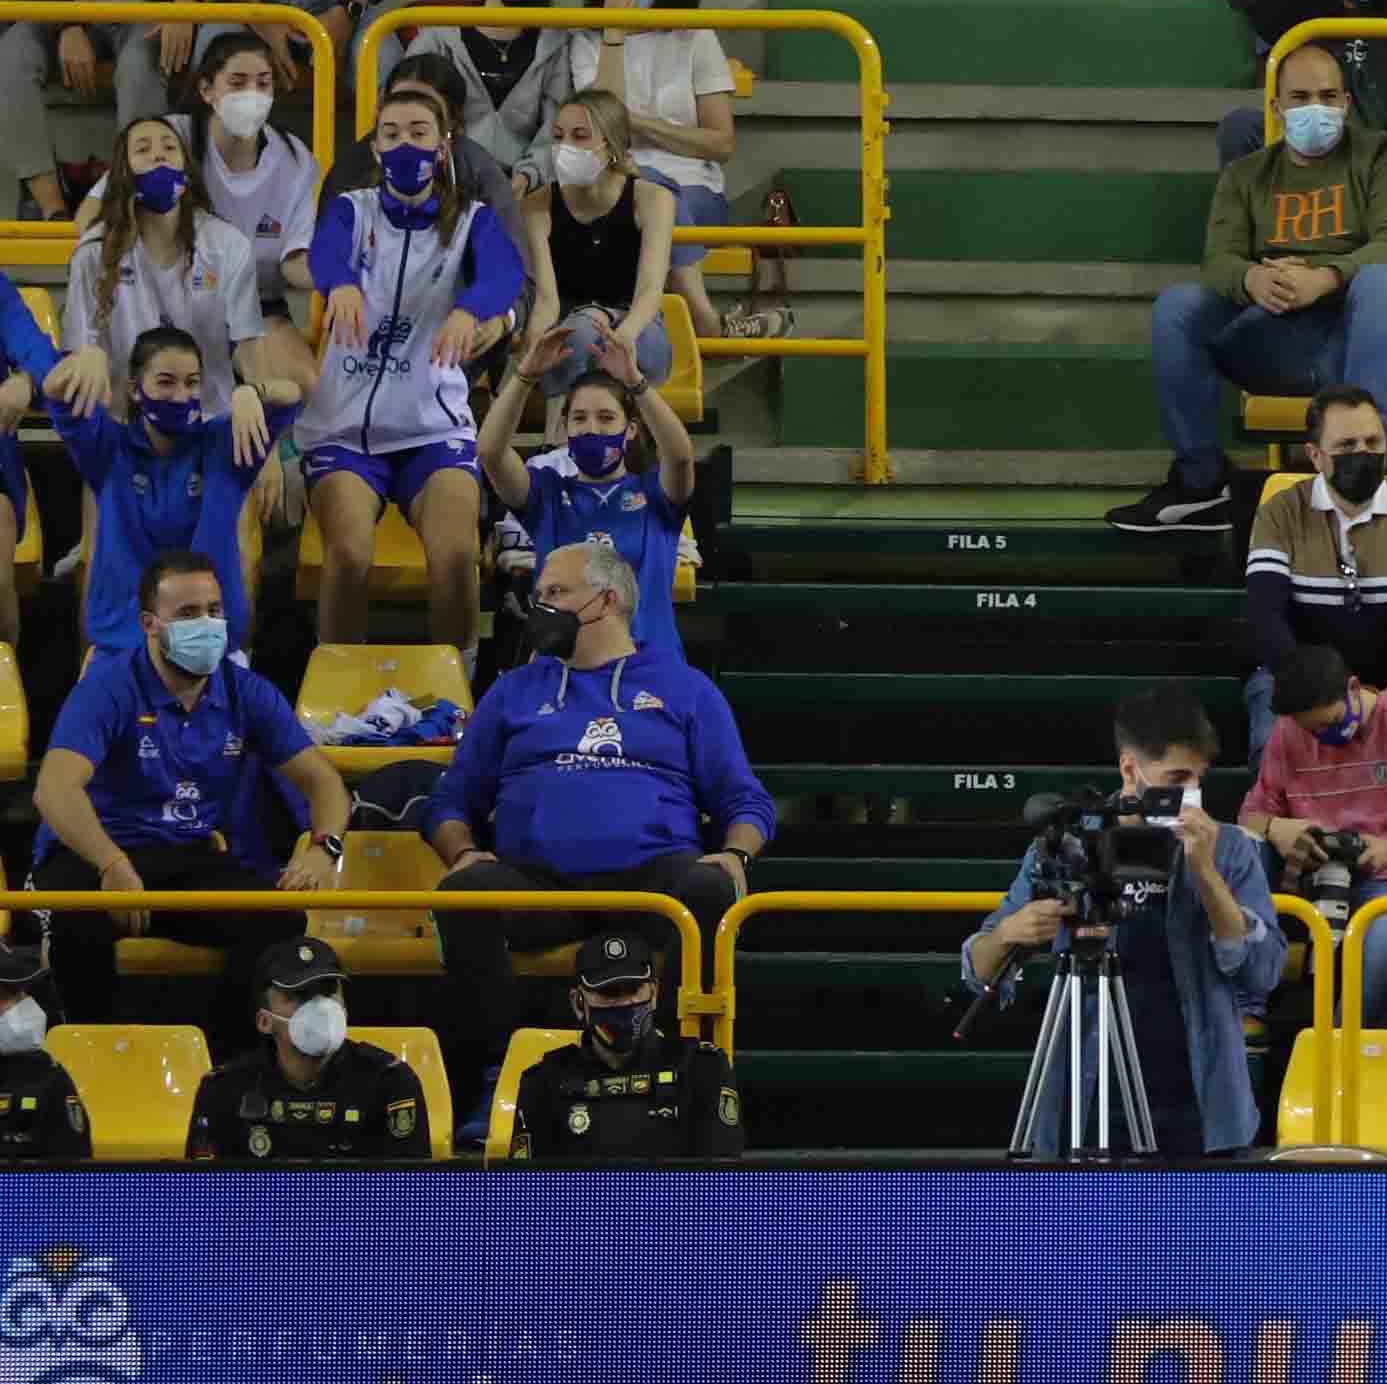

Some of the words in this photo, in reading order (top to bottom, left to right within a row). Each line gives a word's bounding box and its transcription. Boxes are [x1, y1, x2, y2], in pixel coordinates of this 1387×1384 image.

[947, 534, 990, 550] FILA
[993, 535, 1008, 549] 5
[976, 592, 1020, 608] FILA
[1023, 593, 1038, 608] 4
[953, 773, 999, 790] FILA
[1003, 773, 1016, 790] 3
